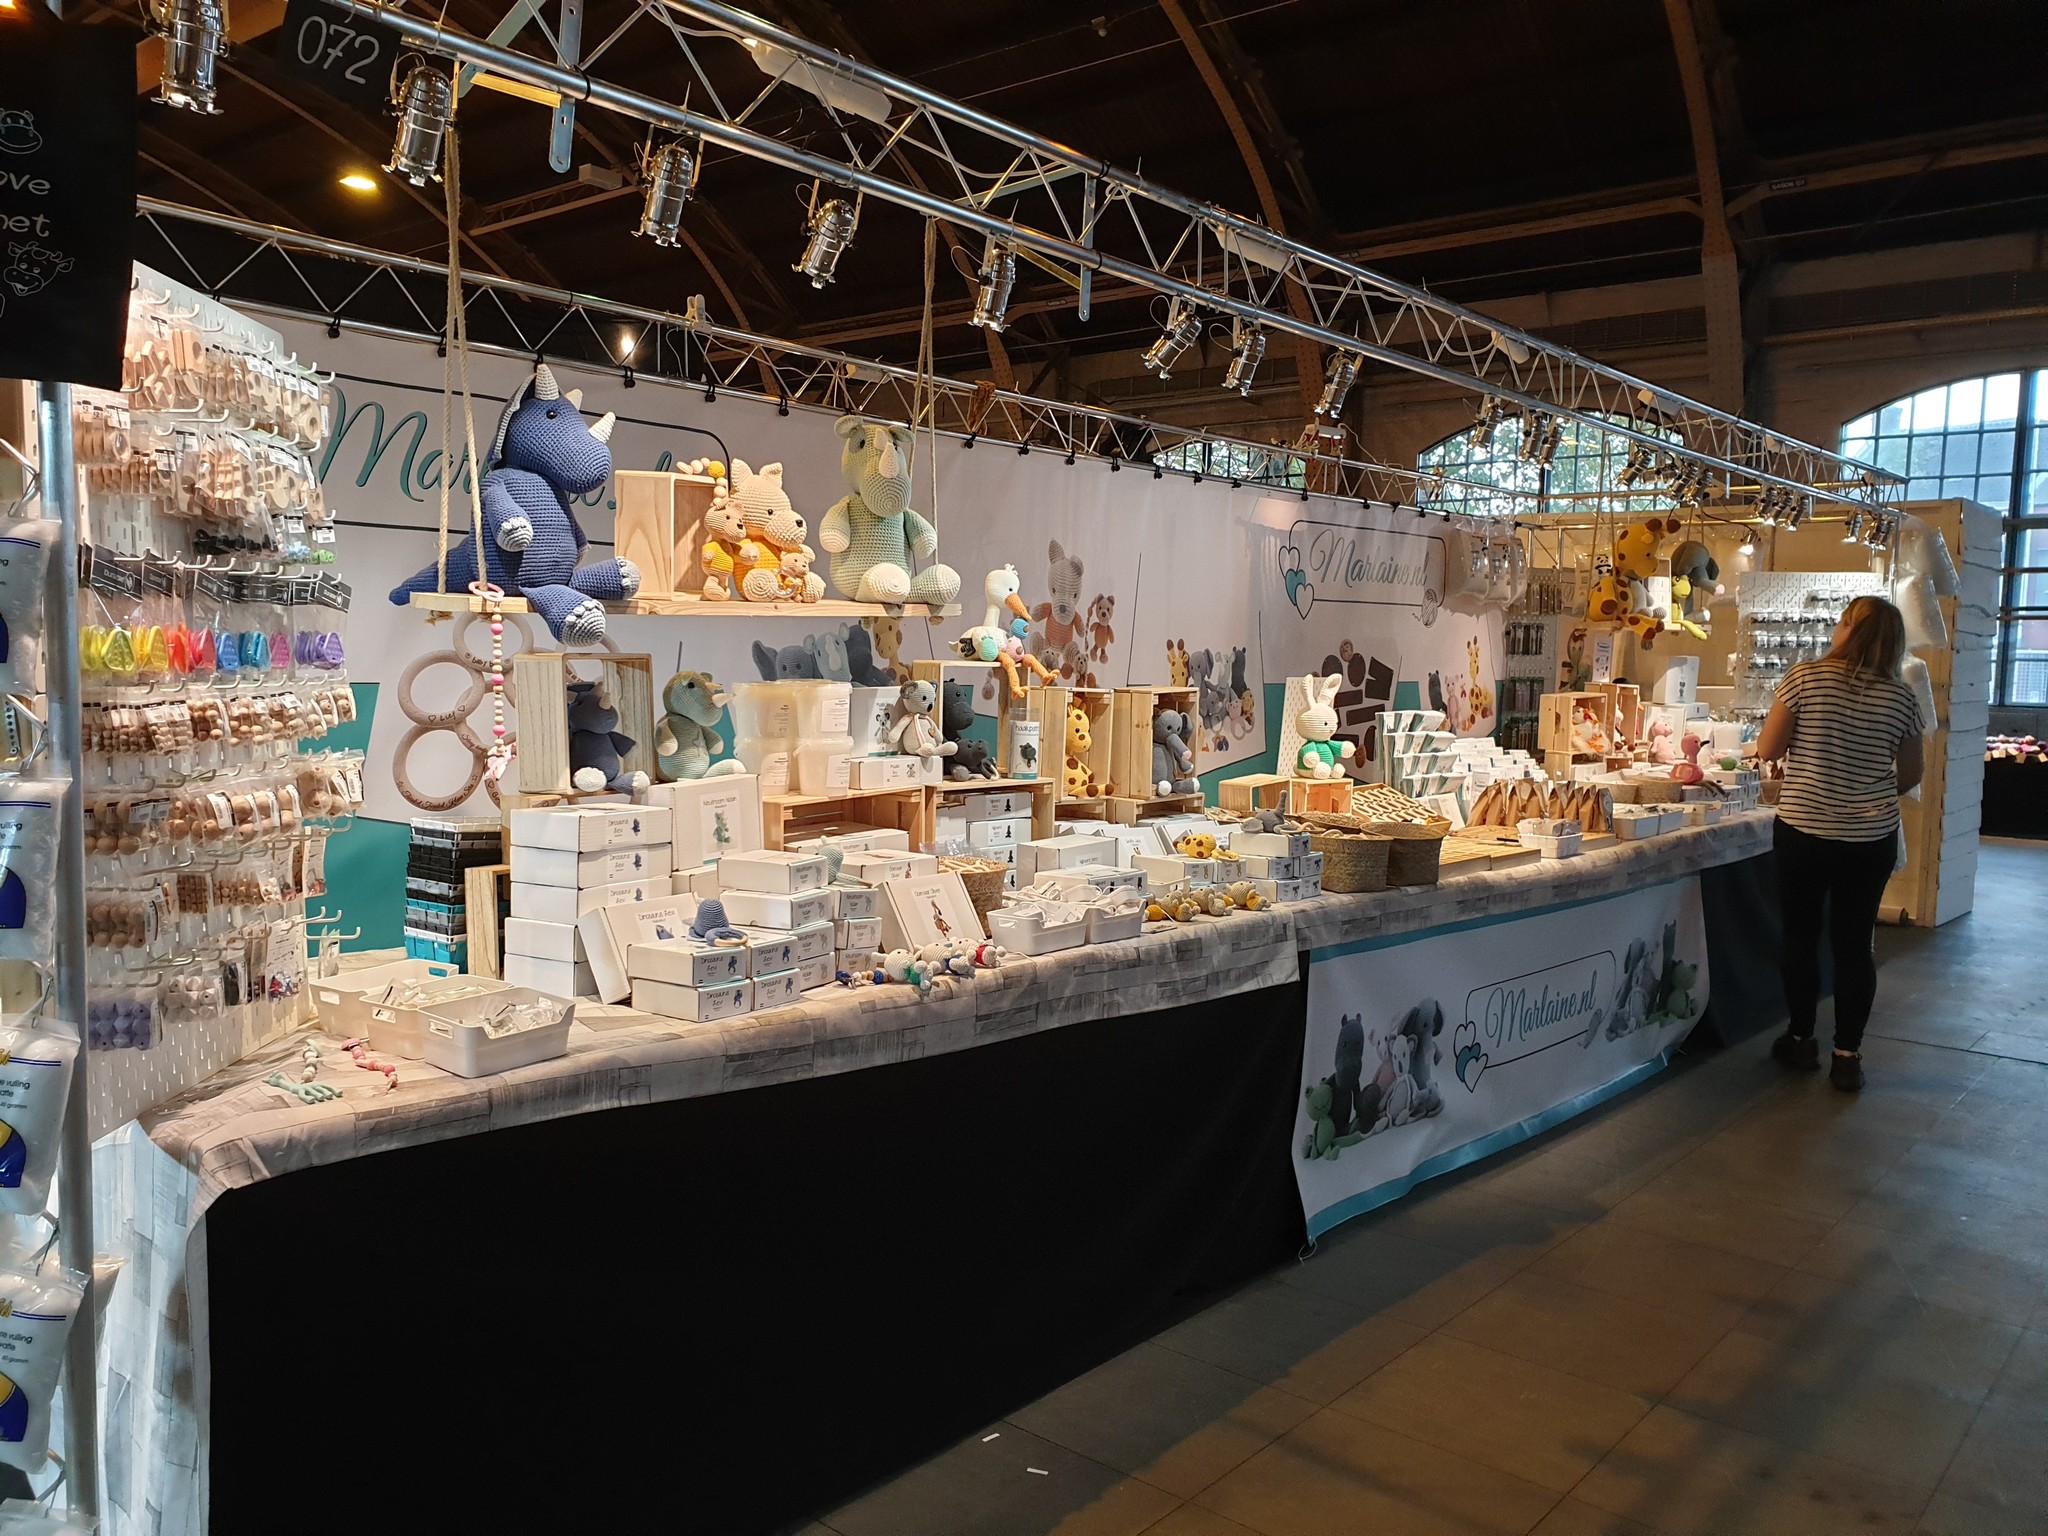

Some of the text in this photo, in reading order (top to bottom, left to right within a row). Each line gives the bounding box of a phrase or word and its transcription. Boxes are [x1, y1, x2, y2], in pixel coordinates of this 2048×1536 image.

[297, 15, 380, 85] 072
[1309, 528, 1430, 588] Marlaine.nl
[1484, 967, 1598, 1049] Marlaine.nl
